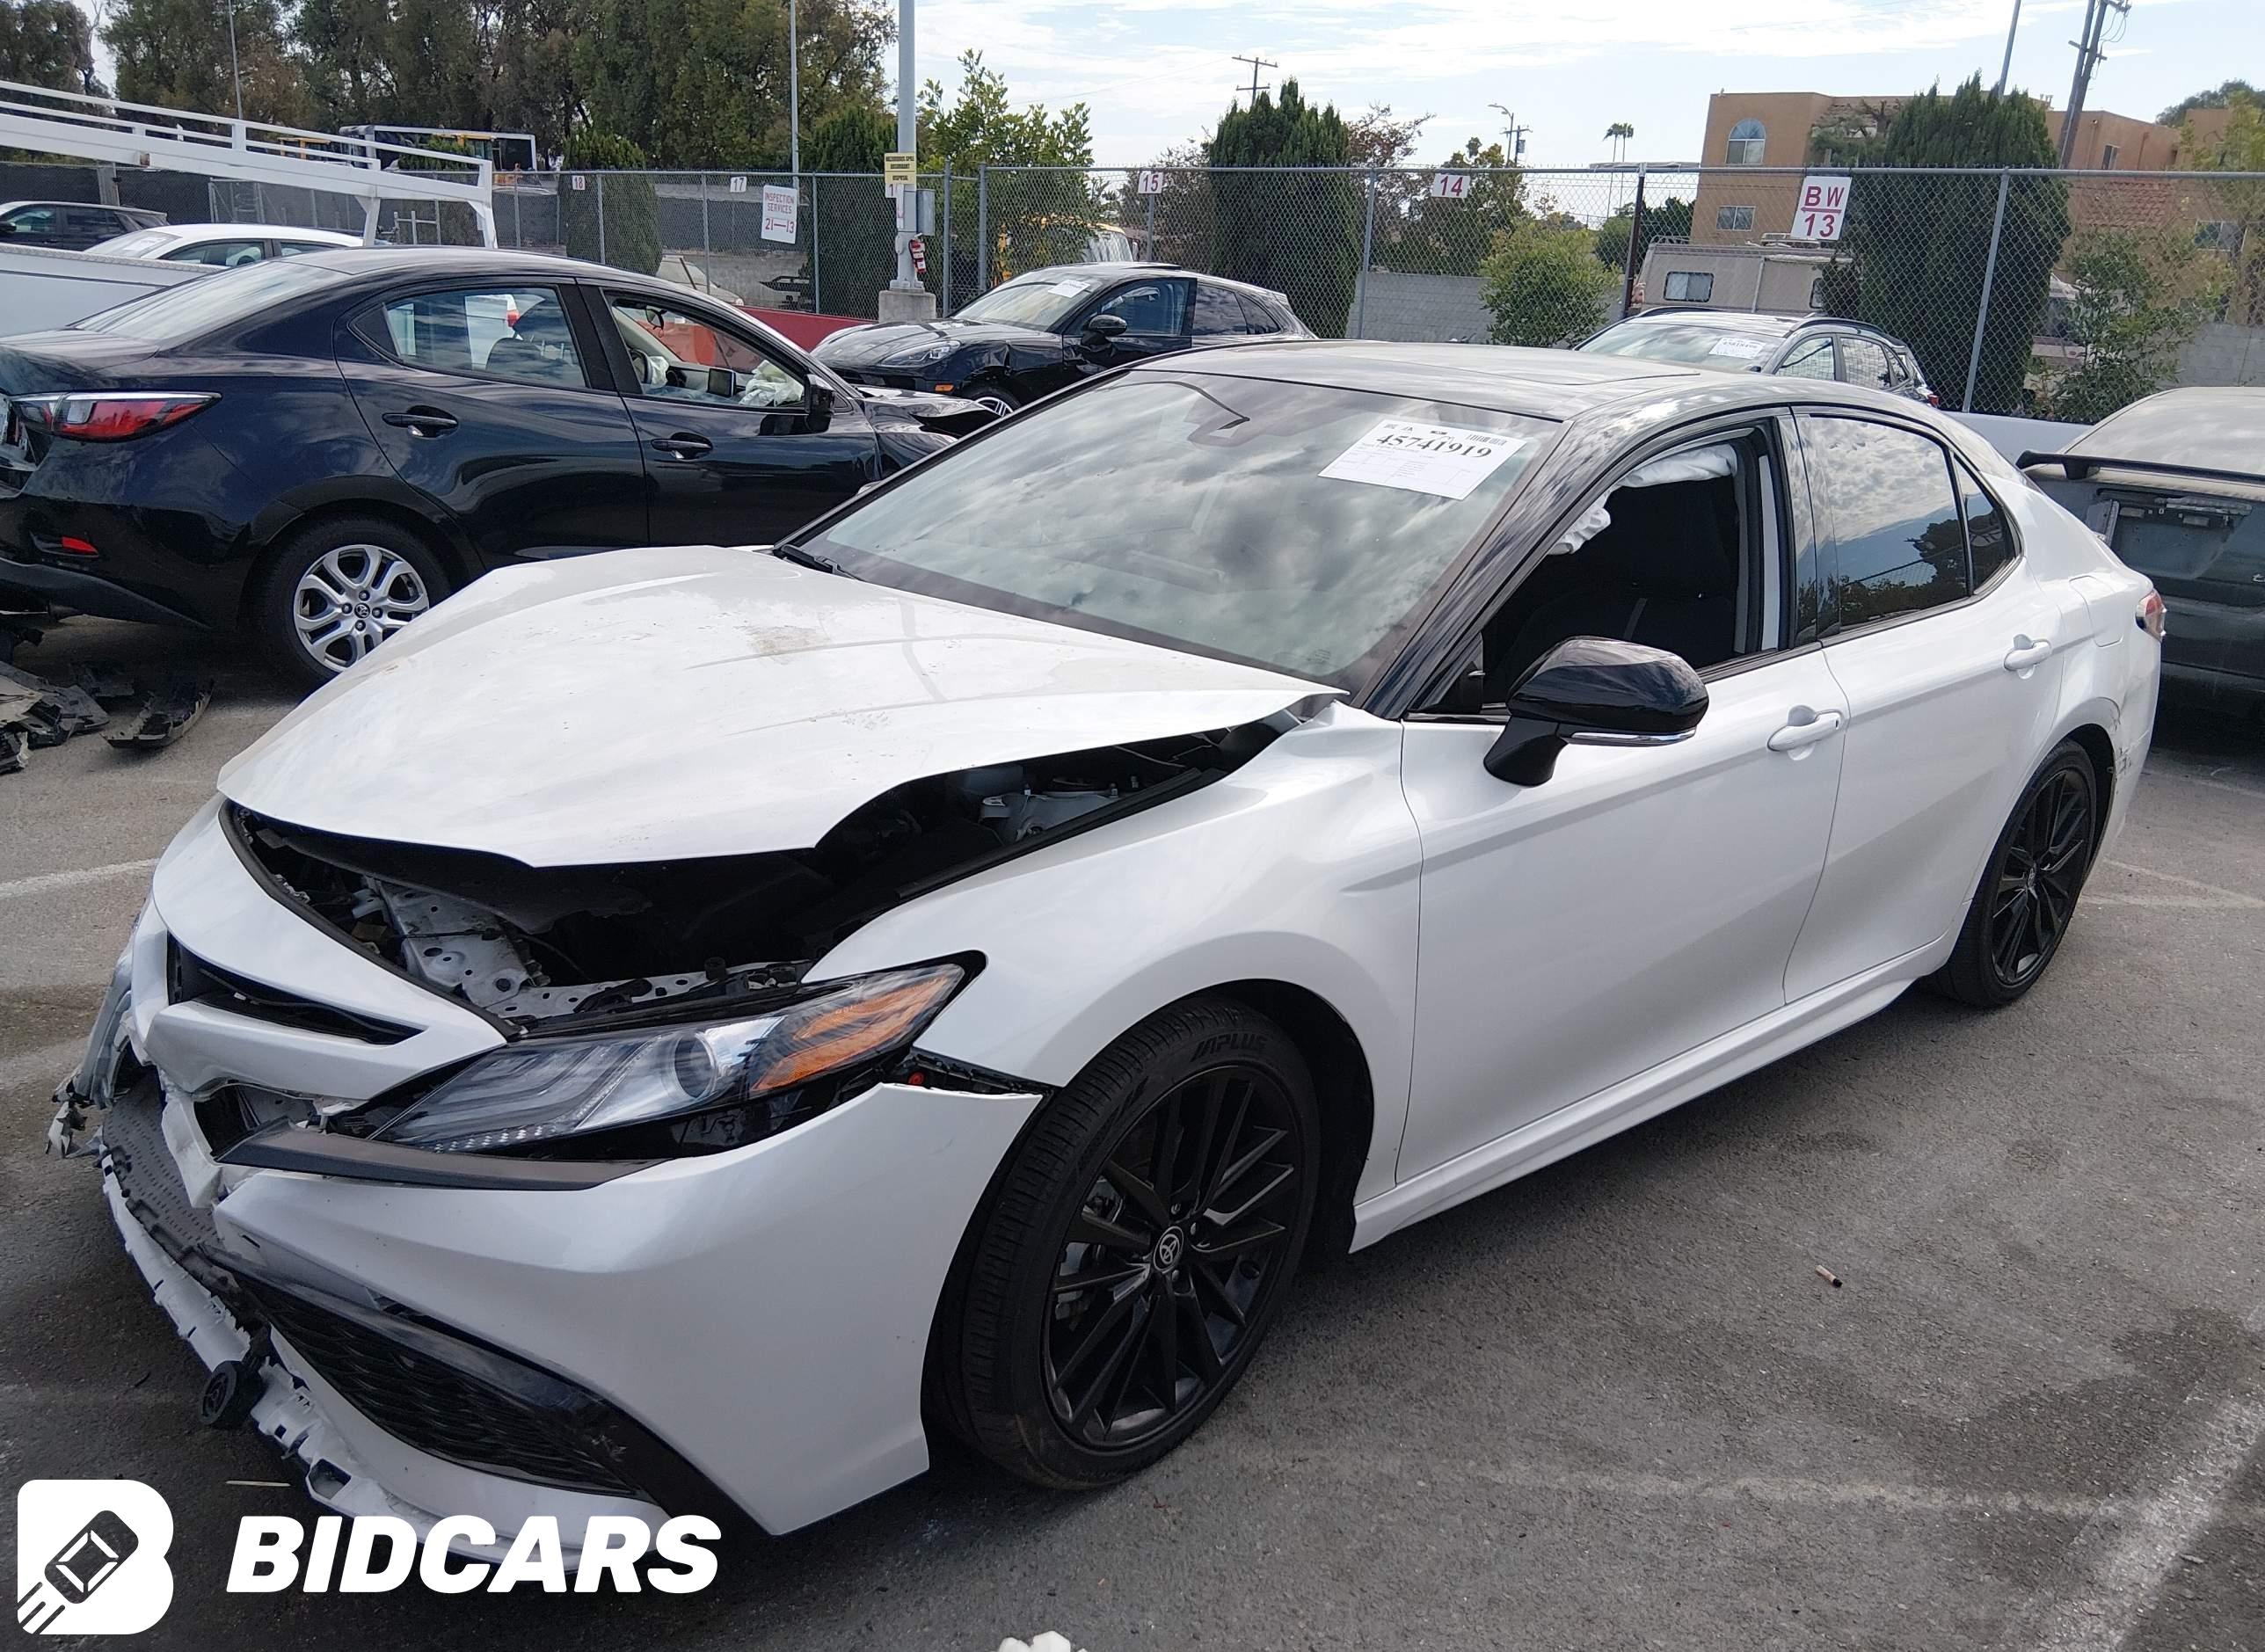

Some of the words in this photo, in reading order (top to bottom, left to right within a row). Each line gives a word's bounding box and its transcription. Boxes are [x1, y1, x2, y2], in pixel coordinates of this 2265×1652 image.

[733, 177, 745, 192] 17
[1142, 174, 1159, 193] 15
[1440, 175, 1463, 197] 14
[765, 192, 795, 204] INSPECTION
[767, 202, 792, 215] SERVICES
[1804, 213, 1835, 237] 13
[1375, 433, 1492, 458] 45741919
